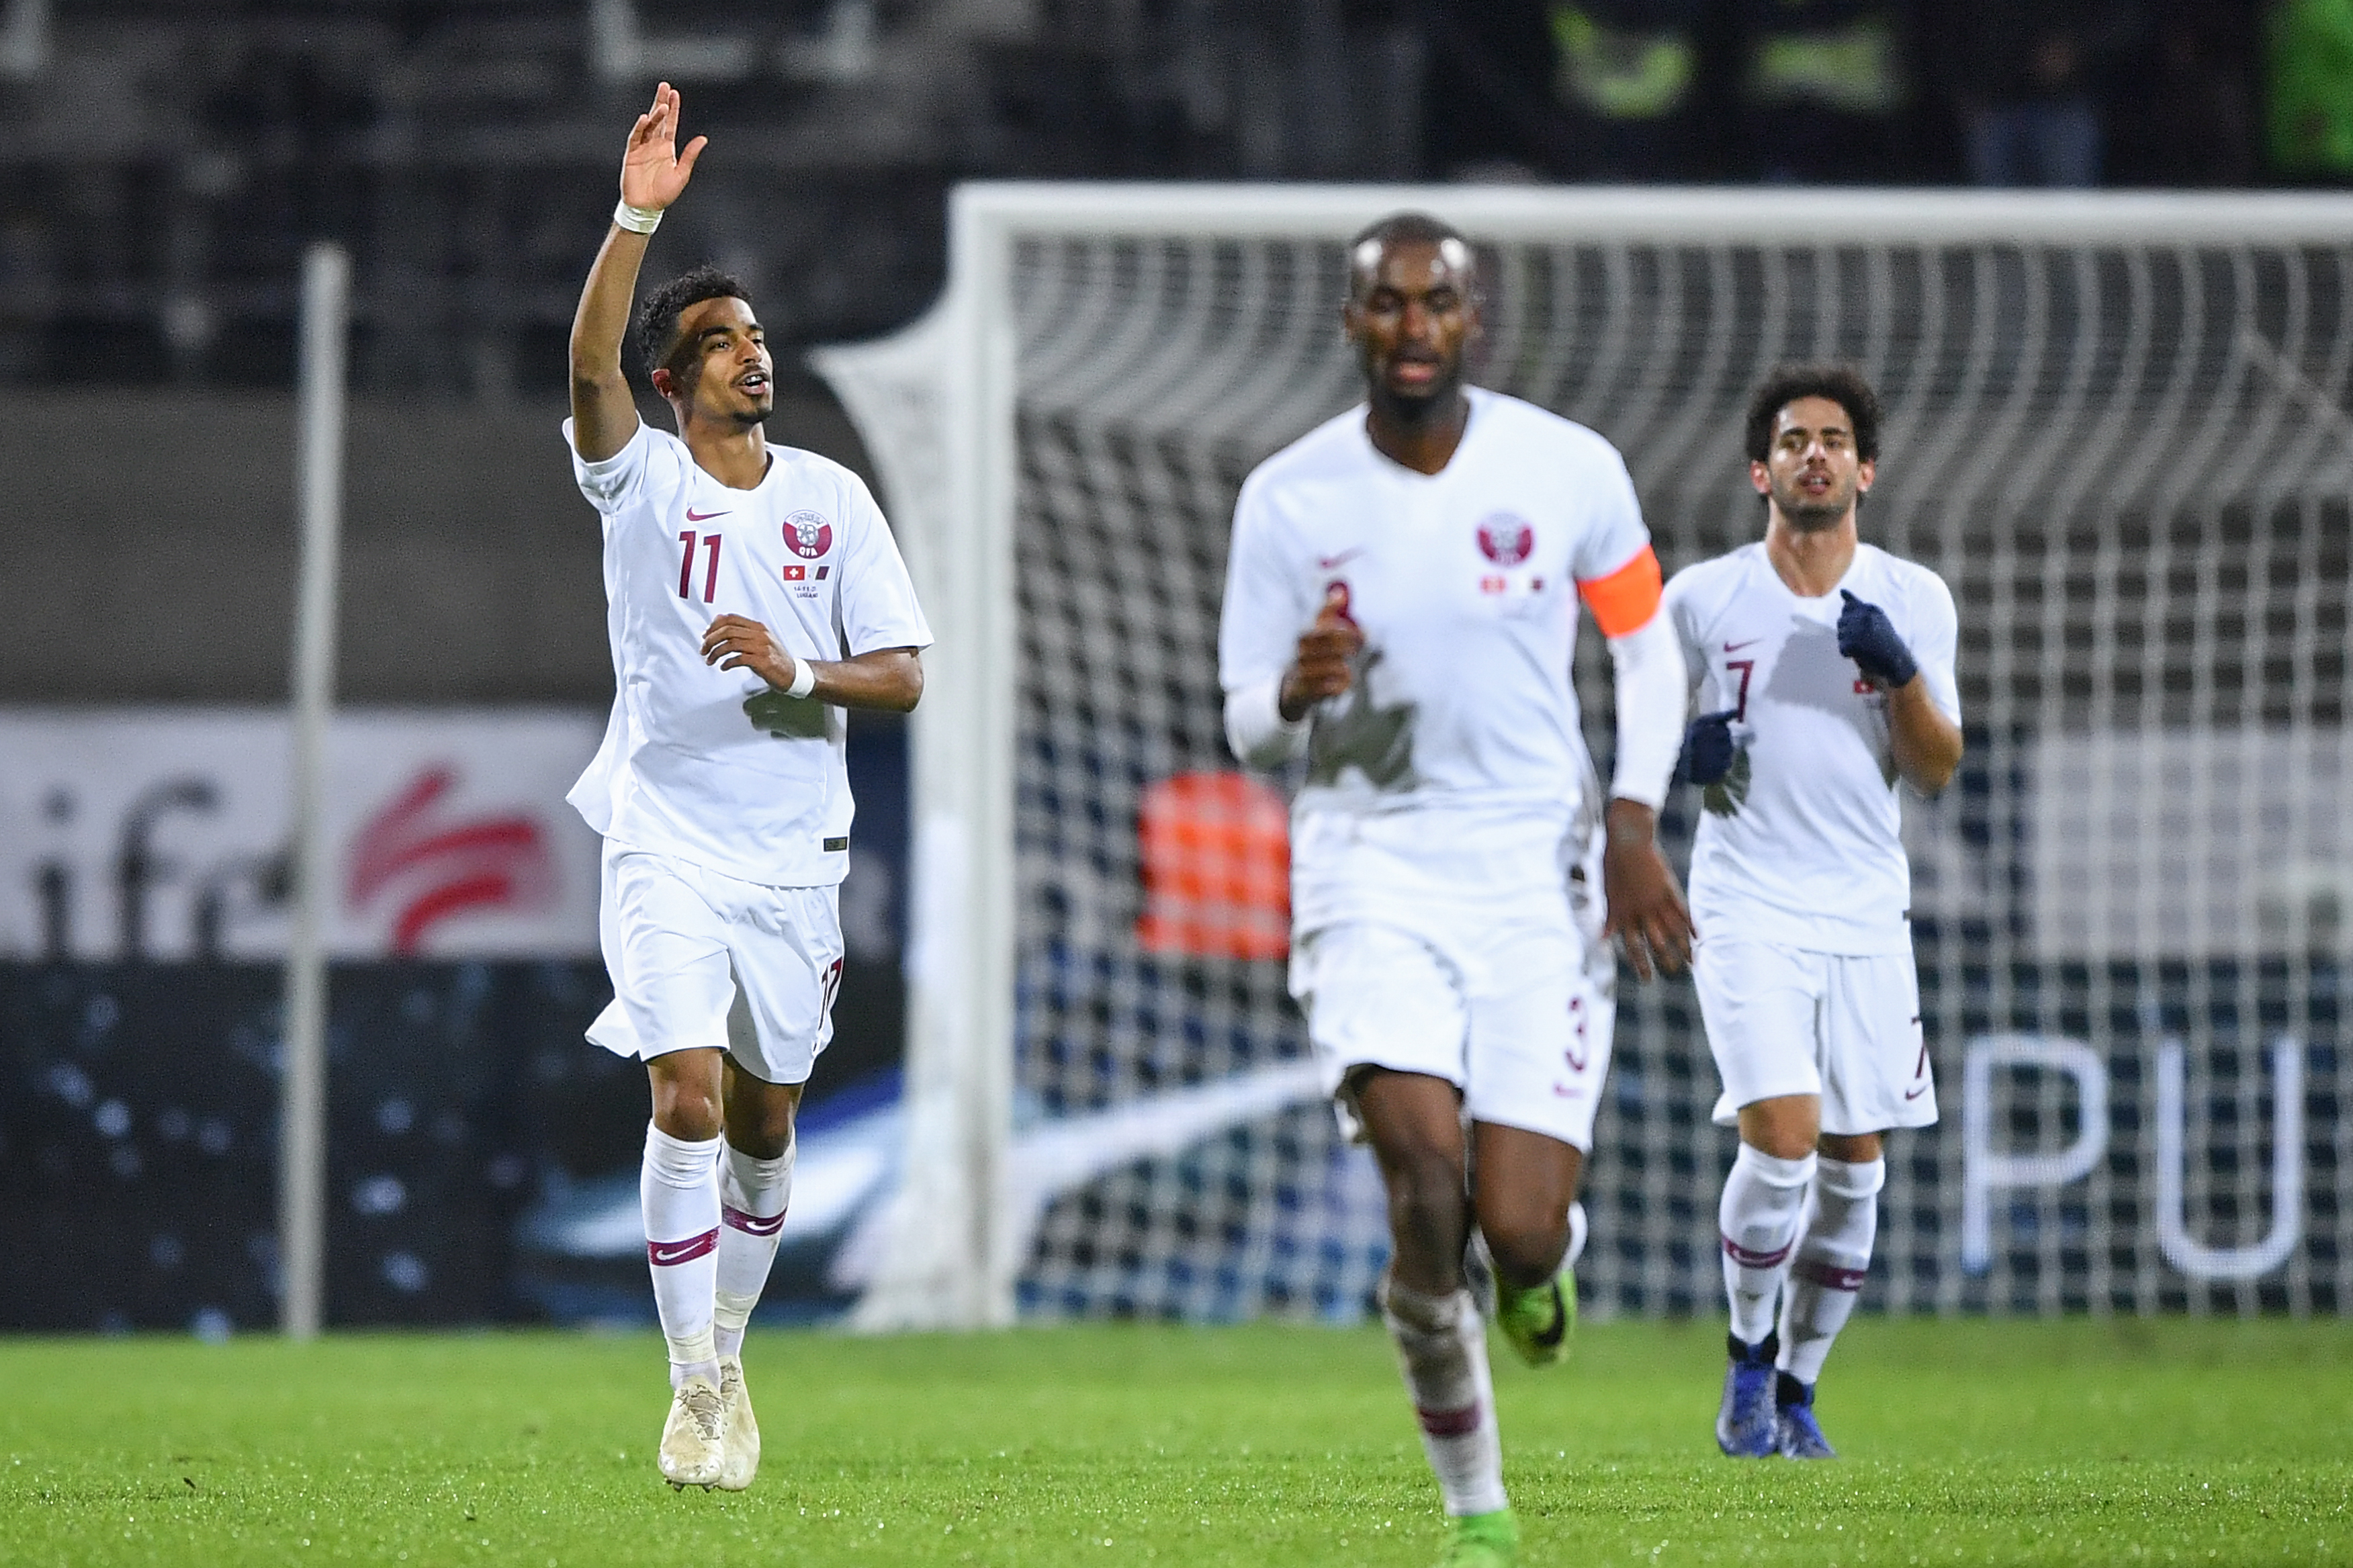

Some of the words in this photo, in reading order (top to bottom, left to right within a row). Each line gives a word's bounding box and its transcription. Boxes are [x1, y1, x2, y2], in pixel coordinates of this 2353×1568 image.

[678, 530, 722, 604] 11
[1726, 660, 1755, 724] 7
[1564, 995, 1589, 1073] 3
